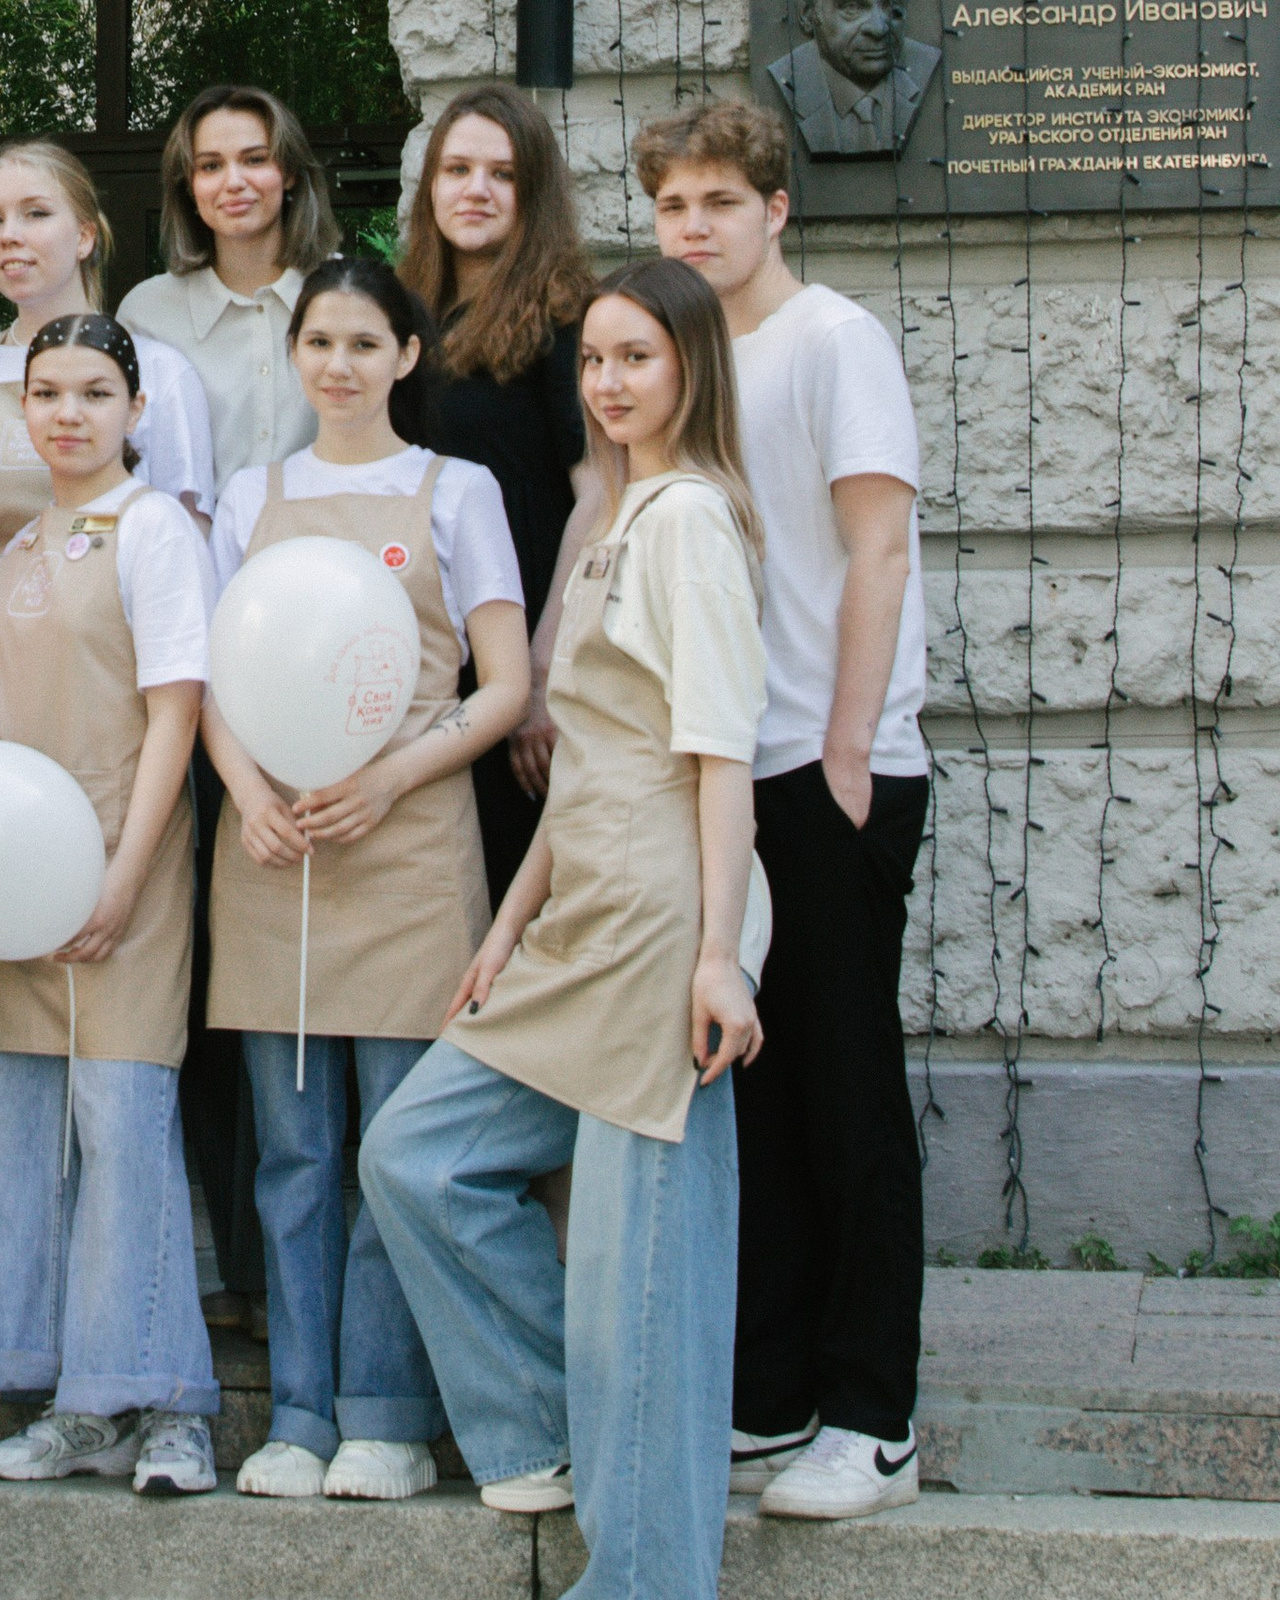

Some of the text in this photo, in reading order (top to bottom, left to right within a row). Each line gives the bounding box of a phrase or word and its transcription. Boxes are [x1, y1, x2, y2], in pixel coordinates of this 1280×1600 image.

[951, 3, 1117, 28] Александр
[952, 65, 1073, 86] ВЫДАЮЩИЙСЯ
[1044, 82, 1166, 98] АКАДЕМИК РАН
[962, 107, 1252, 131] ДИРЕКТОР ИНСТИТУТА ЭКОНОМИКИ
[988, 125, 1228, 145] УРАЛЬСКОГО ОТДЕЛЕНИЯ РАН
[948, 152, 1268, 175] ПОЧЕТНЫЙ ГРАЖДАНИН ЕКАТЕРИНБУРГА
